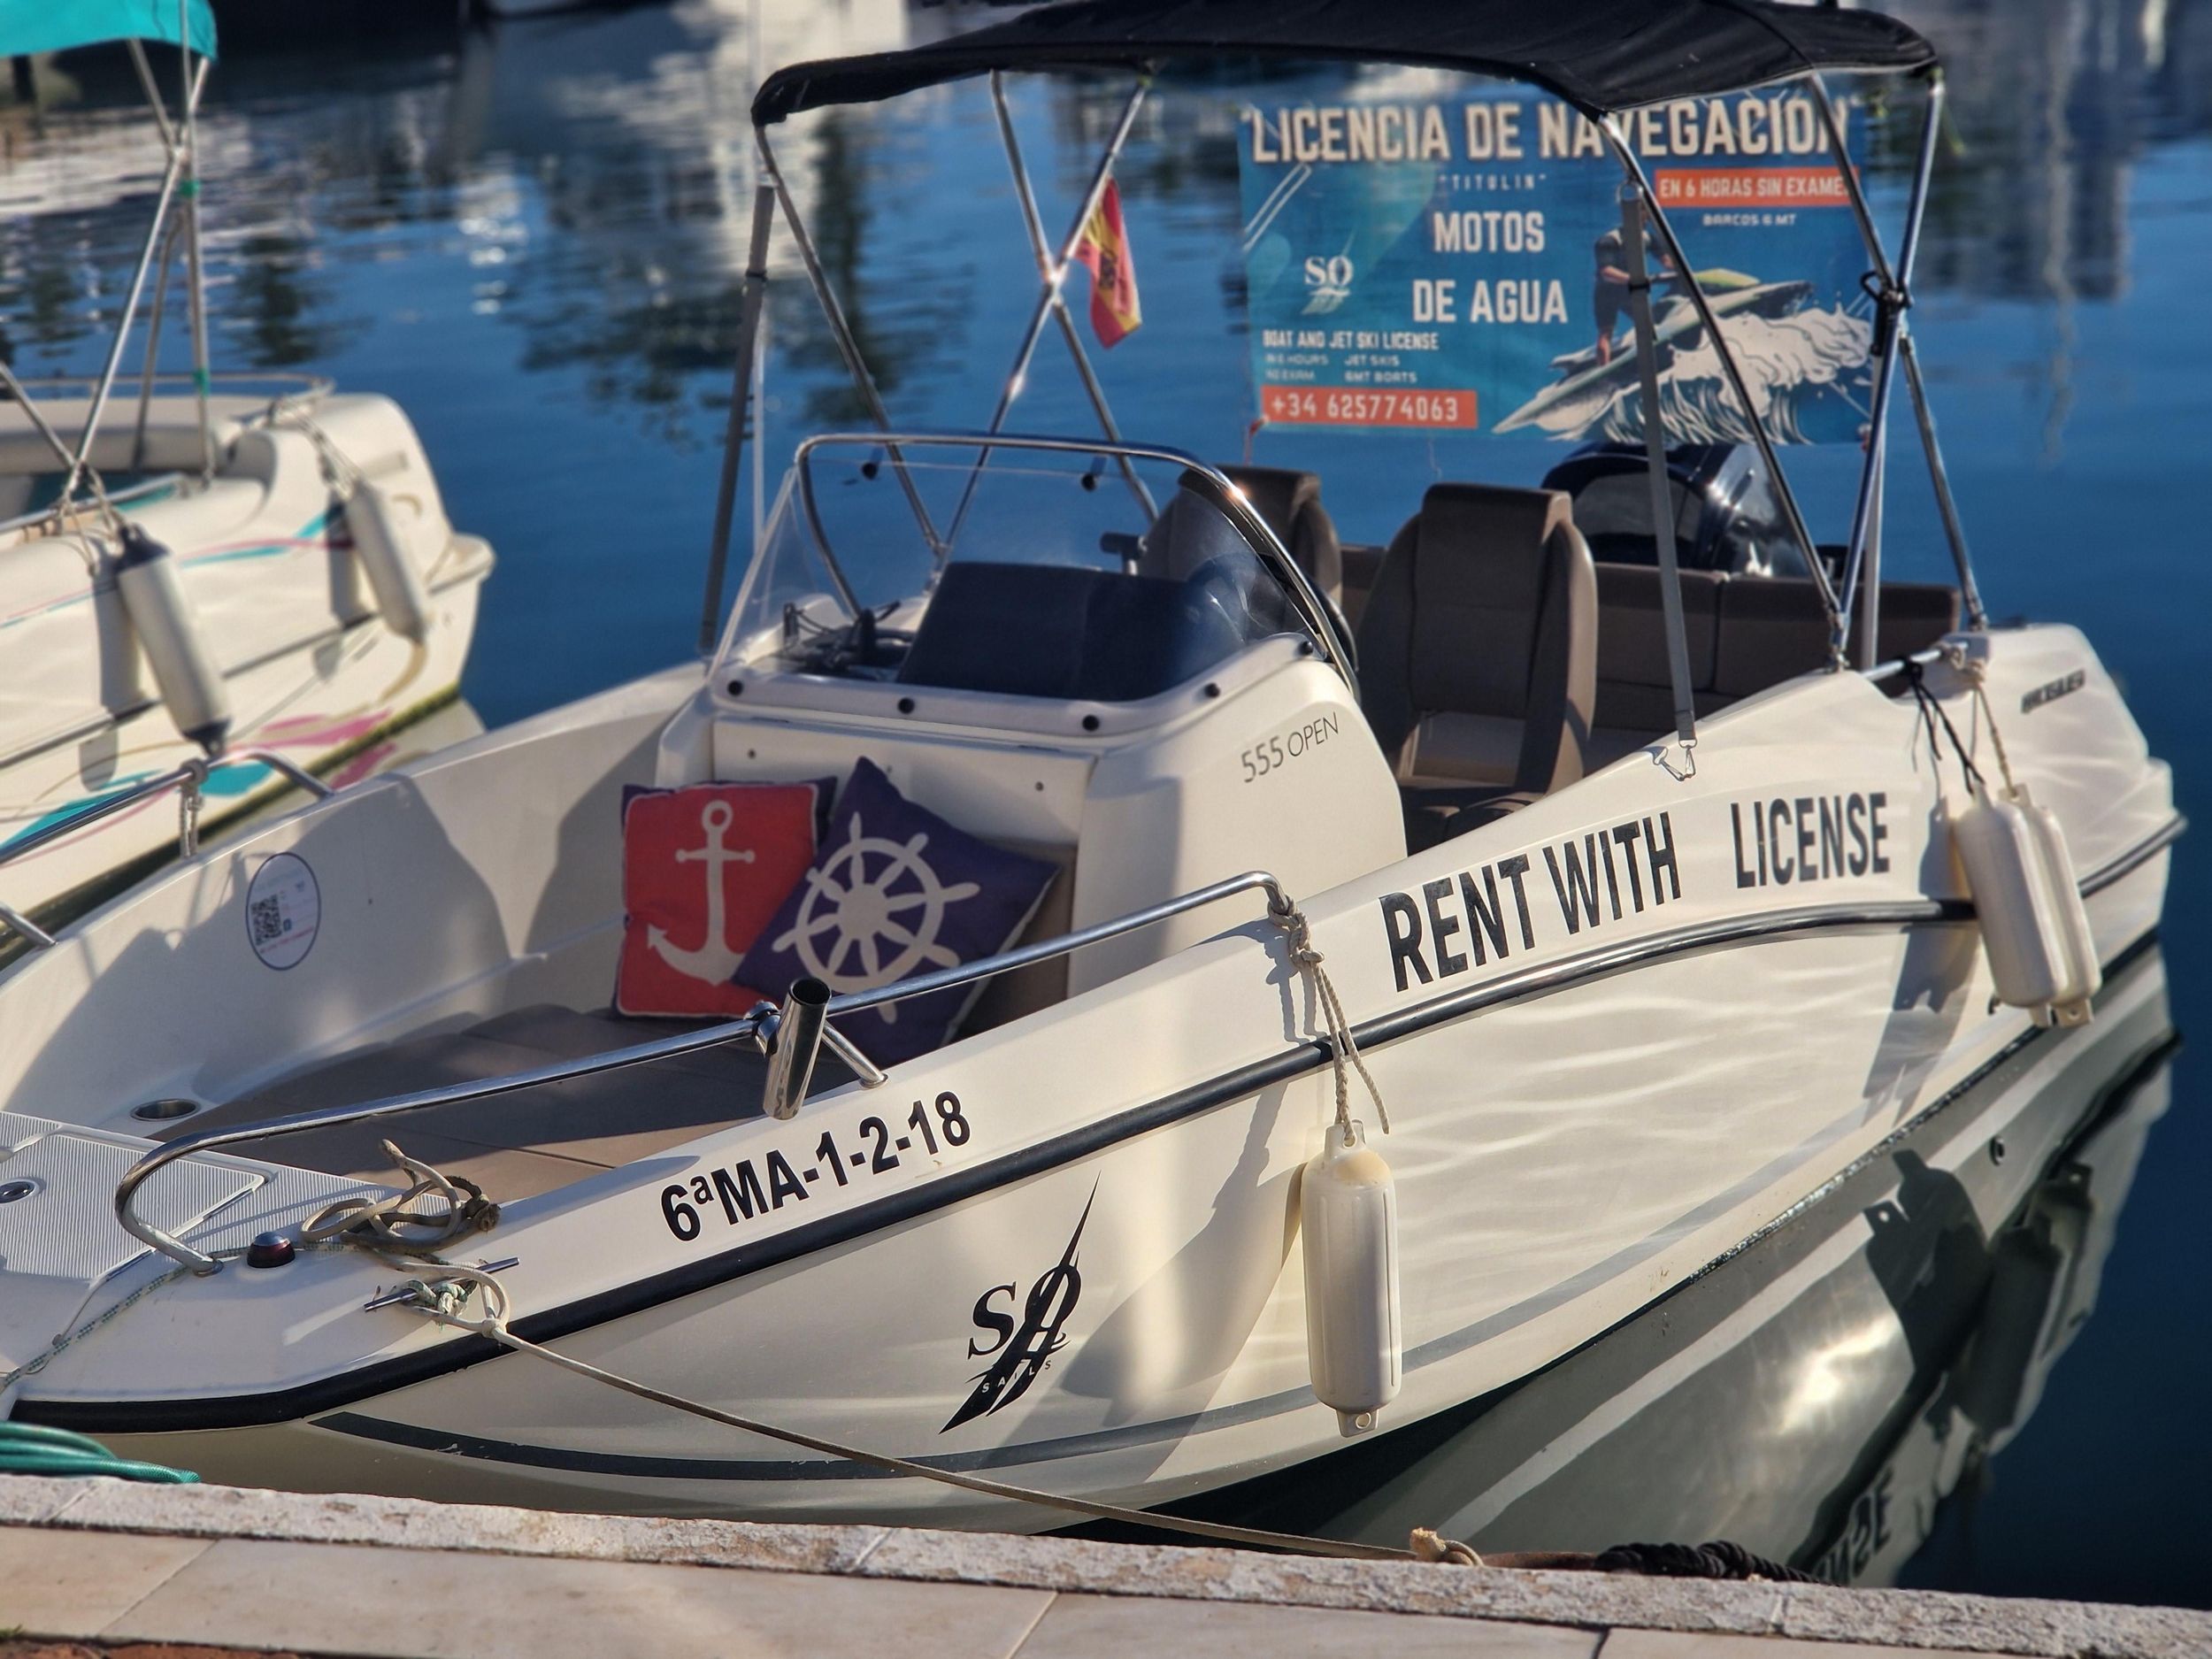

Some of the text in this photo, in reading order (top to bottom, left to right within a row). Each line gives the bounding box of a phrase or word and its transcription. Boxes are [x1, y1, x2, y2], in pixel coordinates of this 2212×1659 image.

[1252, 104, 1451, 163] LICENCIA
[1465, 103, 1524, 158] DE
[1659, 175, 1851, 198] EN 6 HORAS SIN EXAME
[1433, 210, 1545, 253] MOTOS
[1413, 279, 1567, 323] DE AGUA
[1263, 330, 1440, 350] BOAT AND JET SKI LICENSE
[1344, 354, 1367, 366] JET
[1271, 394, 1459, 421] +34 625774063
[1241, 710, 1339, 783] 555 OPEN
[1379, 792, 1890, 992] RENT WITH LICENSE
[981, 1359, 1053, 1394] SAILS
